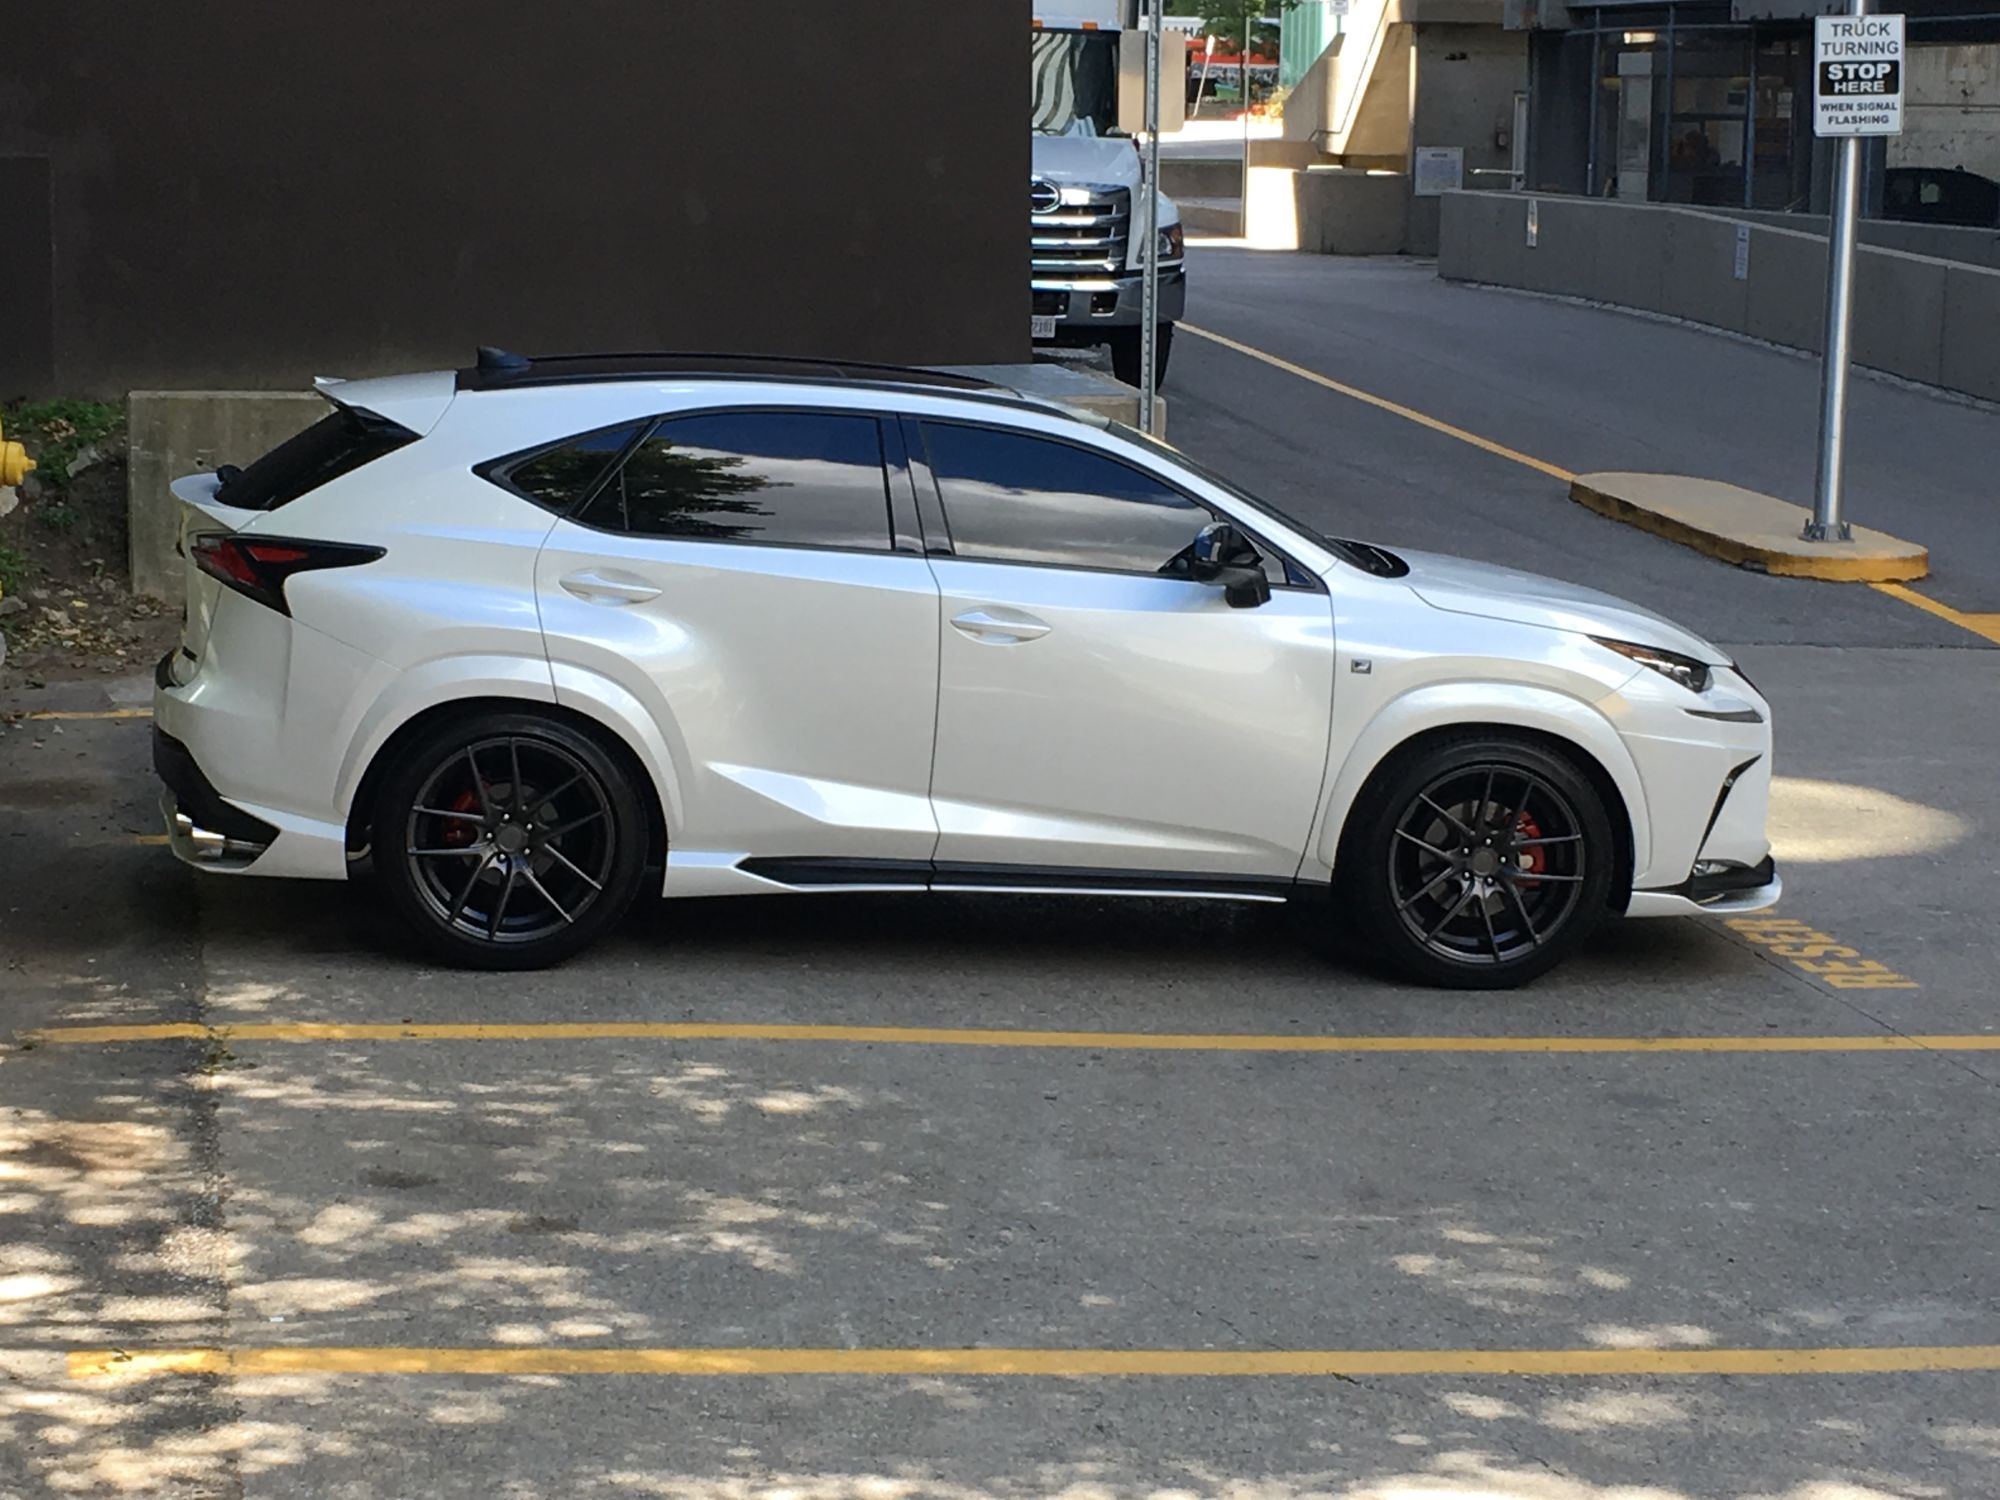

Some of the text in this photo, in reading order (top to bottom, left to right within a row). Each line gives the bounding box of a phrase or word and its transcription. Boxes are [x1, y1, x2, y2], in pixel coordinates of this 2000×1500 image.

[1831, 22, 1890, 37] TRUCK
[1821, 40, 1899, 56] TURNING
[1828, 63, 1892, 80] STOP
[1833, 80, 1885, 93] HERE
[1820, 101, 1898, 112] WHEN SIGNAL
[1828, 115, 1890, 125] FLASHING
[1724, 907, 1921, 989] RESER
